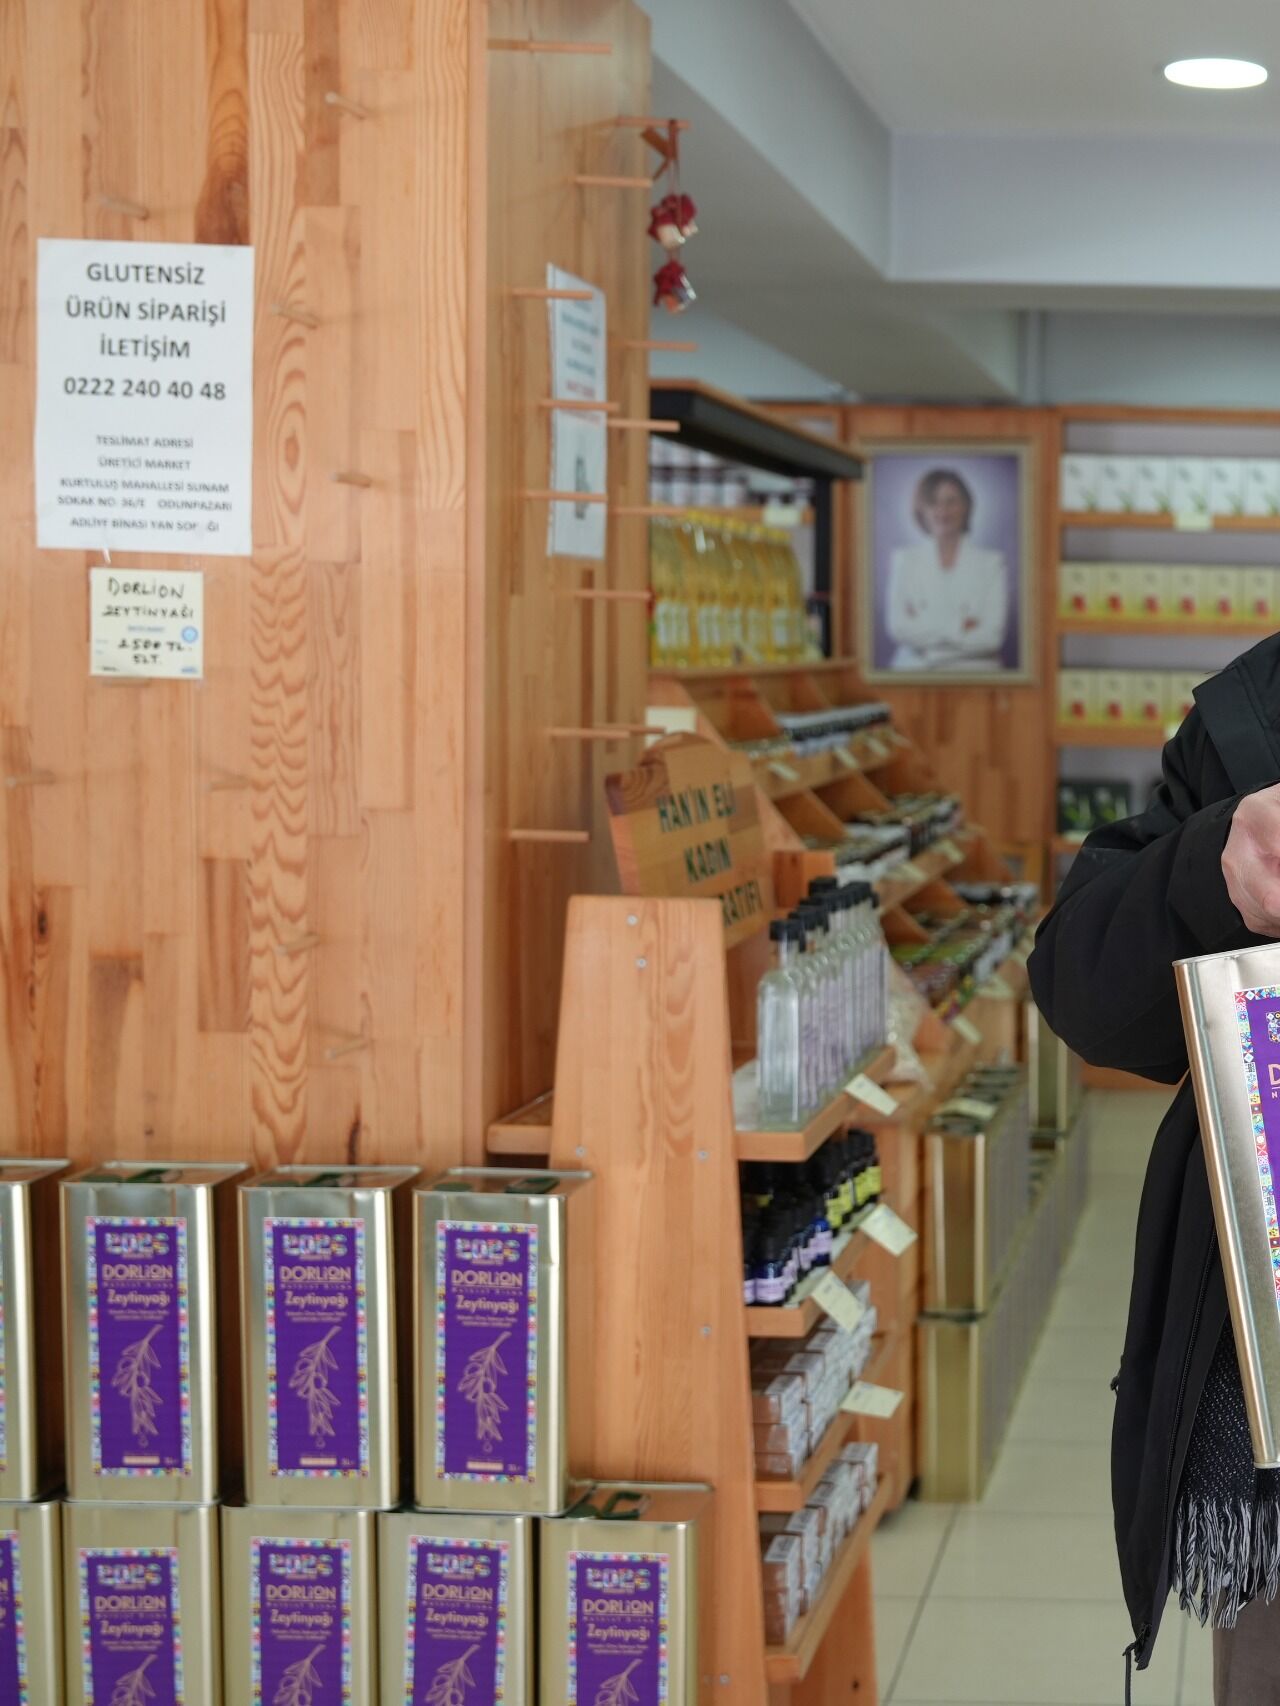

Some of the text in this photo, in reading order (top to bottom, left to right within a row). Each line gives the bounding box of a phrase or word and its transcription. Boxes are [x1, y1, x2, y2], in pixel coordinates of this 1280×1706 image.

[86, 261, 205, 285] GLUTENSİZ
[65, 295, 226, 327] ÜRÜN SİPARİŞİ
[99, 333, 191, 362] İLETİŞİM
[63, 376, 227, 401] 0222 240 40 48
